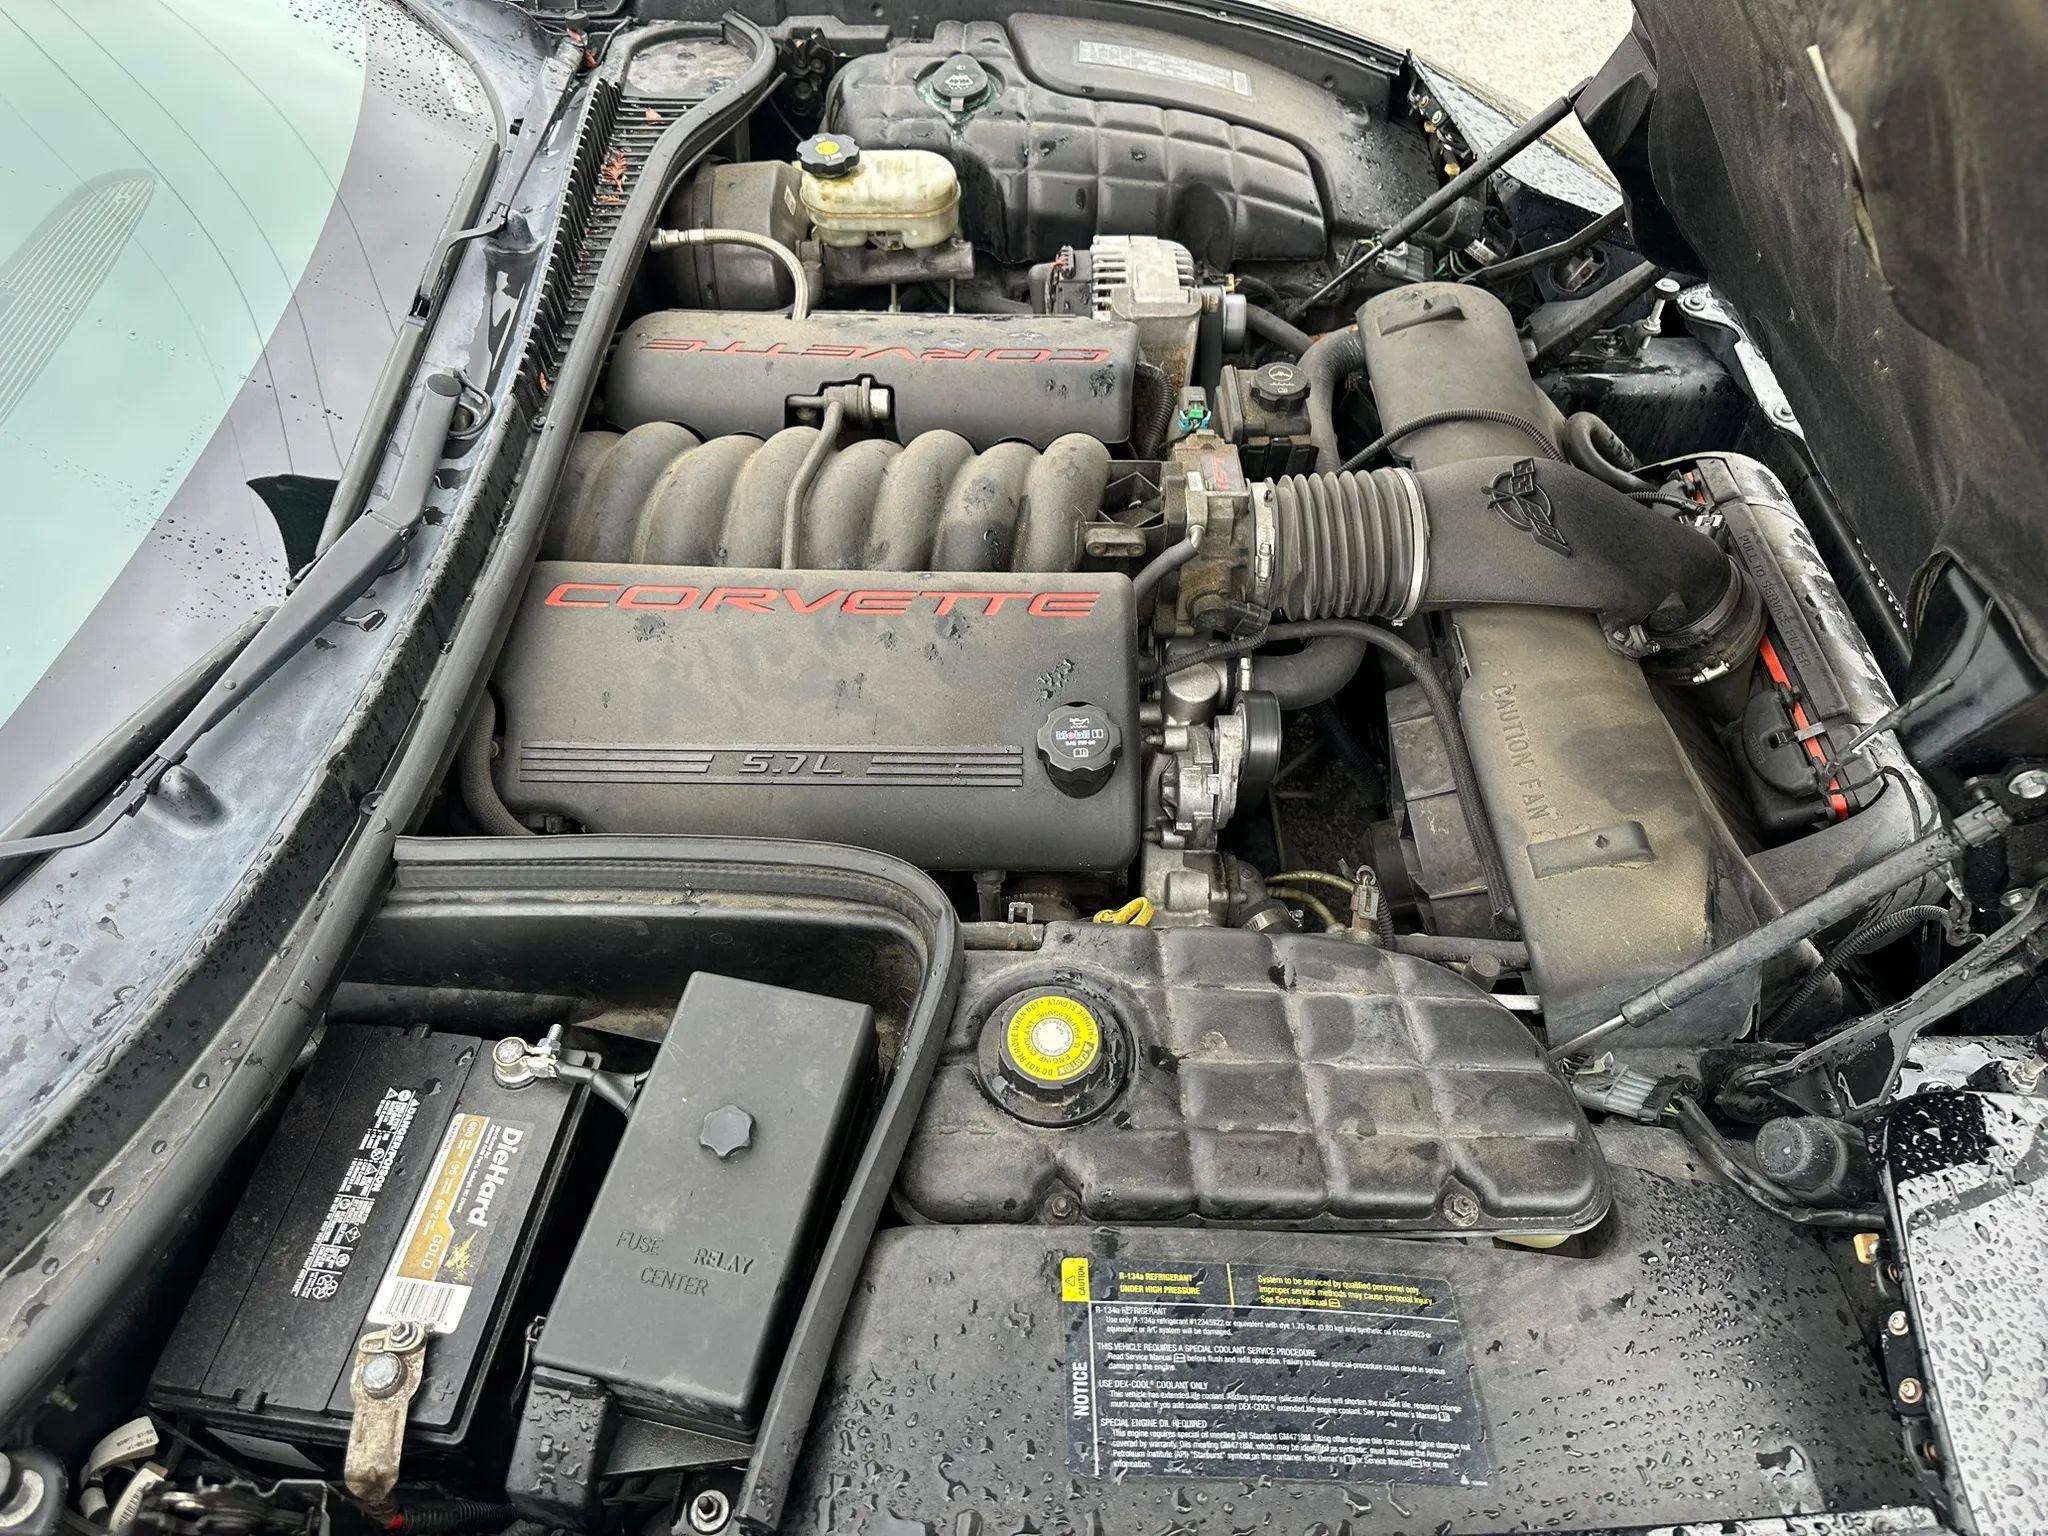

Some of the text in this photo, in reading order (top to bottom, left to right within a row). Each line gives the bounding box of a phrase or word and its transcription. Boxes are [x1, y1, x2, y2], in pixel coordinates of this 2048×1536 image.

[641, 338, 1114, 363] CORVETTE
[545, 581, 1101, 617] CORVETTE
[1739, 535, 1812, 669] PULL TO SERVICE FILTER
[1490, 684, 1549, 821] CAUTION FAN
[737, 752, 843, 774] 5.7L
[1047, 999, 1077, 1011] SLOWLY
[1023, 1019, 1036, 1056] COOLANT
[1011, 1032, 1026, 1062] REMOVE
[1024, 1061, 1040, 1073] NOT
[1039, 1054, 1070, 1063] ENGINE
[1058, 1052, 1089, 1075] CAUTION
[1042, 1068, 1053, 1076] DO
[371, 1106, 416, 1192] DANGER/POISON
[465, 1126, 524, 1227] DieHard
[419, 1234, 443, 1269] GOLD
[616, 1230, 755, 1276] FUSE RELAY
[639, 1265, 709, 1296] CENTER
[1145, 1273, 1192, 1281] REFRIGERANT
[1257, 1275, 1283, 1285] System
[1302, 1277, 1332, 1286] serviced
[1341, 1280, 1371, 1291] qualified
[1371, 1282, 1404, 1293] personnel
[1119, 1284, 1200, 1294] UNDER HIGH PRESSURE
[1258, 1286, 1290, 1295] Improper
[1290, 1287, 1316, 1295] service
[1317, 1289, 1346, 1297] methods
[1347, 1292, 1362, 1300] may
[1384, 1294, 1413, 1303] personal
[1274, 1296, 1301, 1304] Service
[1301, 1297, 1328, 1306] Manual
[1120, 1306, 1166, 1315] REFRIGERANT
[1155, 1317, 1188, 1326] refrigerant
[1232, 1320, 1263, 1329] equivalent
[1113, 1342, 1142, 1350] VEHICLE
[1143, 1343, 1177, 1351] REQUIRES
[1213, 1345, 1245, 1353] COOLANT
[1247, 1347, 1275, 1355] SERVICE
[1276, 1348, 1317, 1357] PROCEDURE
[1107, 1362, 1133, 1370] damage
[1072, 1362, 1090, 1416] NOTICE
[1097, 1379, 1208, 1389] USE COOLANT ONLY
[1100, 1418, 1129, 1426] SPECIAL
[1131, 1418, 1157, 1426] ENGINE
[1171, 1419, 1208, 1428] REQUIRED
[1126, 1429, 1148, 1438] engine
[1275, 1444, 1290, 1452] may
